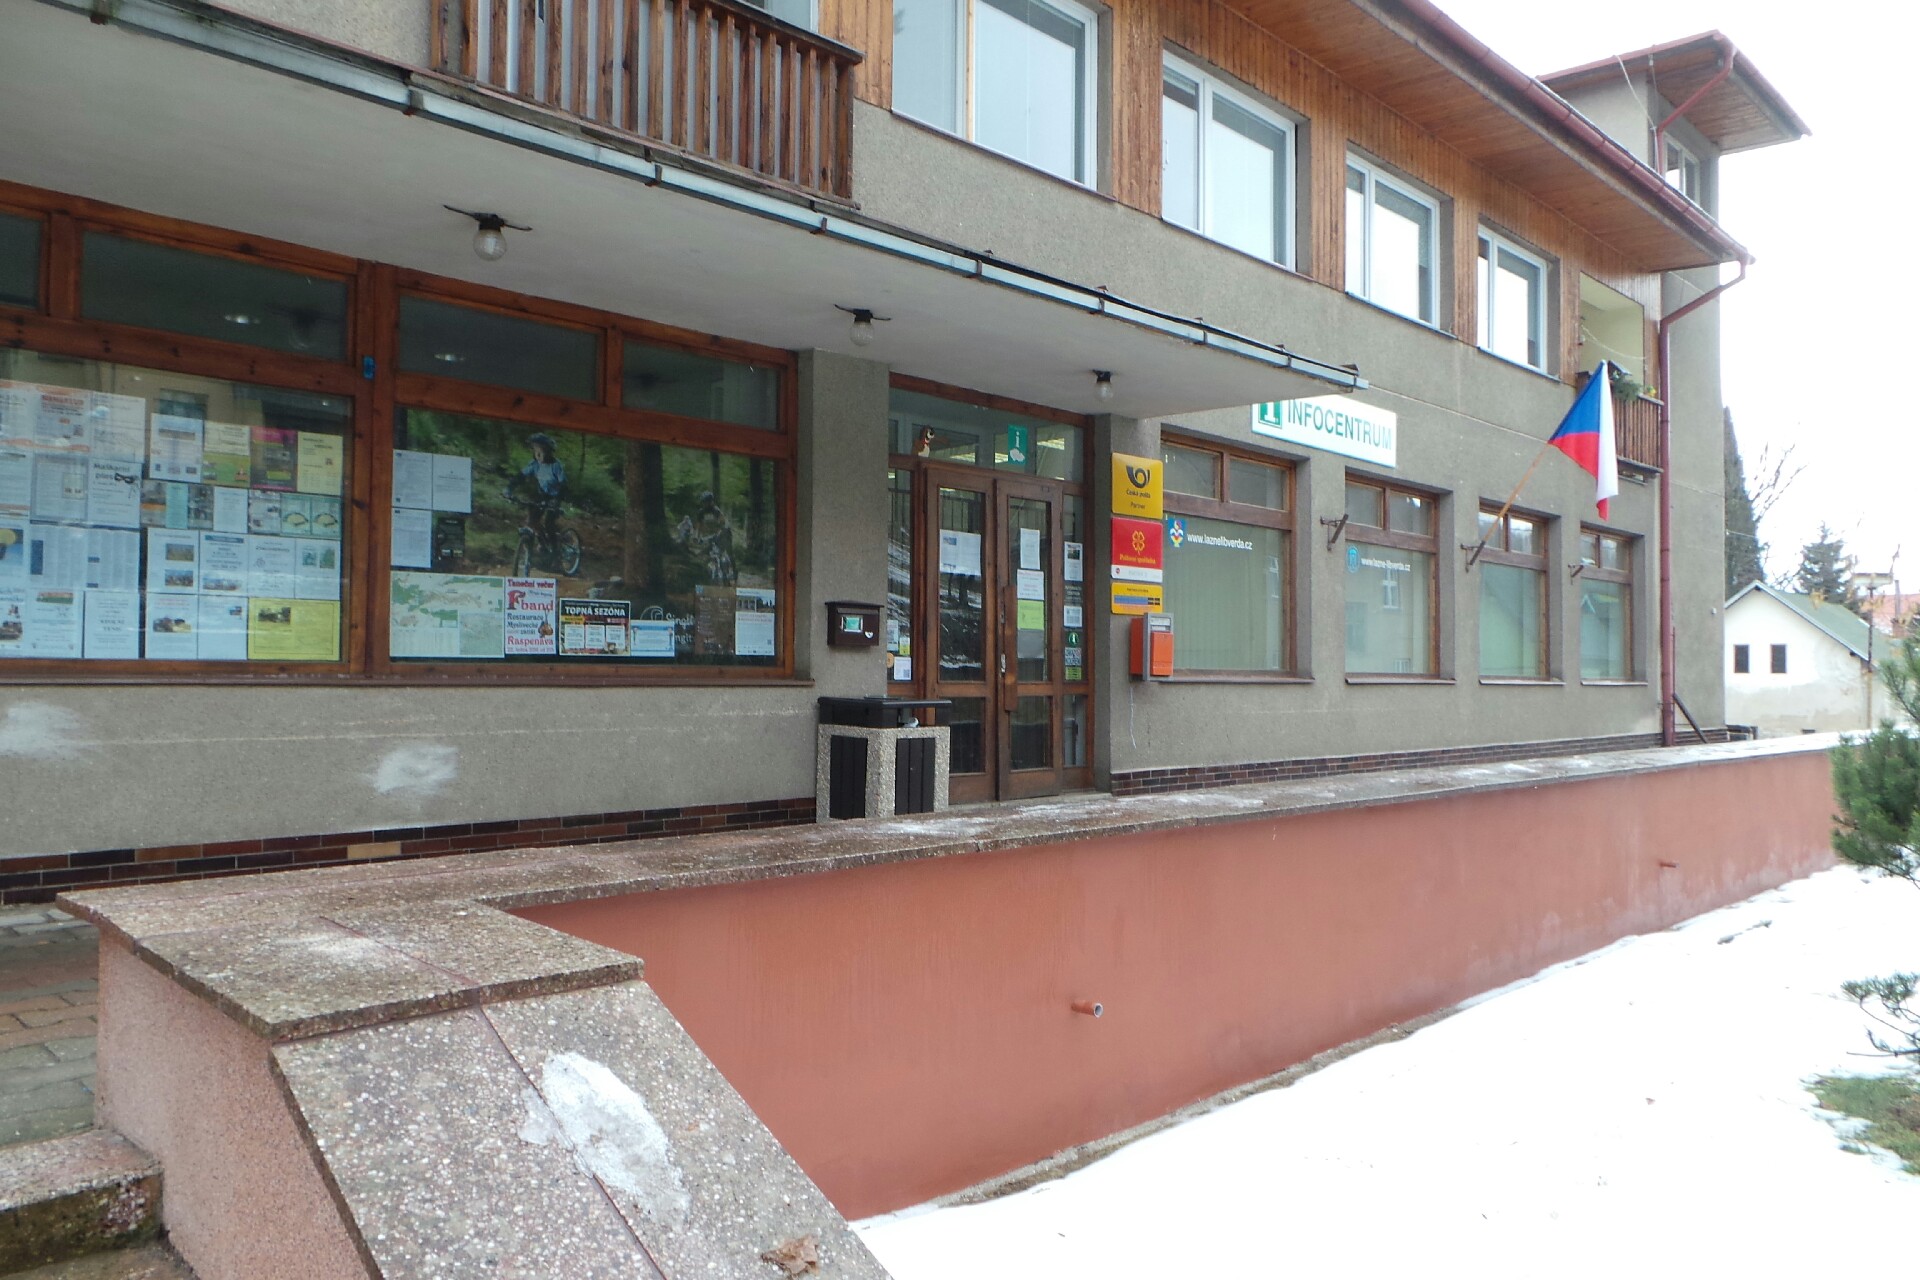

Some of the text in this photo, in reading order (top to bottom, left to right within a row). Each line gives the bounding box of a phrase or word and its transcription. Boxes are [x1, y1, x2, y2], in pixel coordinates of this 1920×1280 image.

[1288, 399, 1392, 450] INFOCENTRUM
[1187, 533, 1253, 550] www.laznelibverda.cz
[507, 578, 554, 589] Taneční večer
[564, 606, 626, 616] TOPNÁ SEZÓNA
[507, 613, 544, 621] Restaurace
